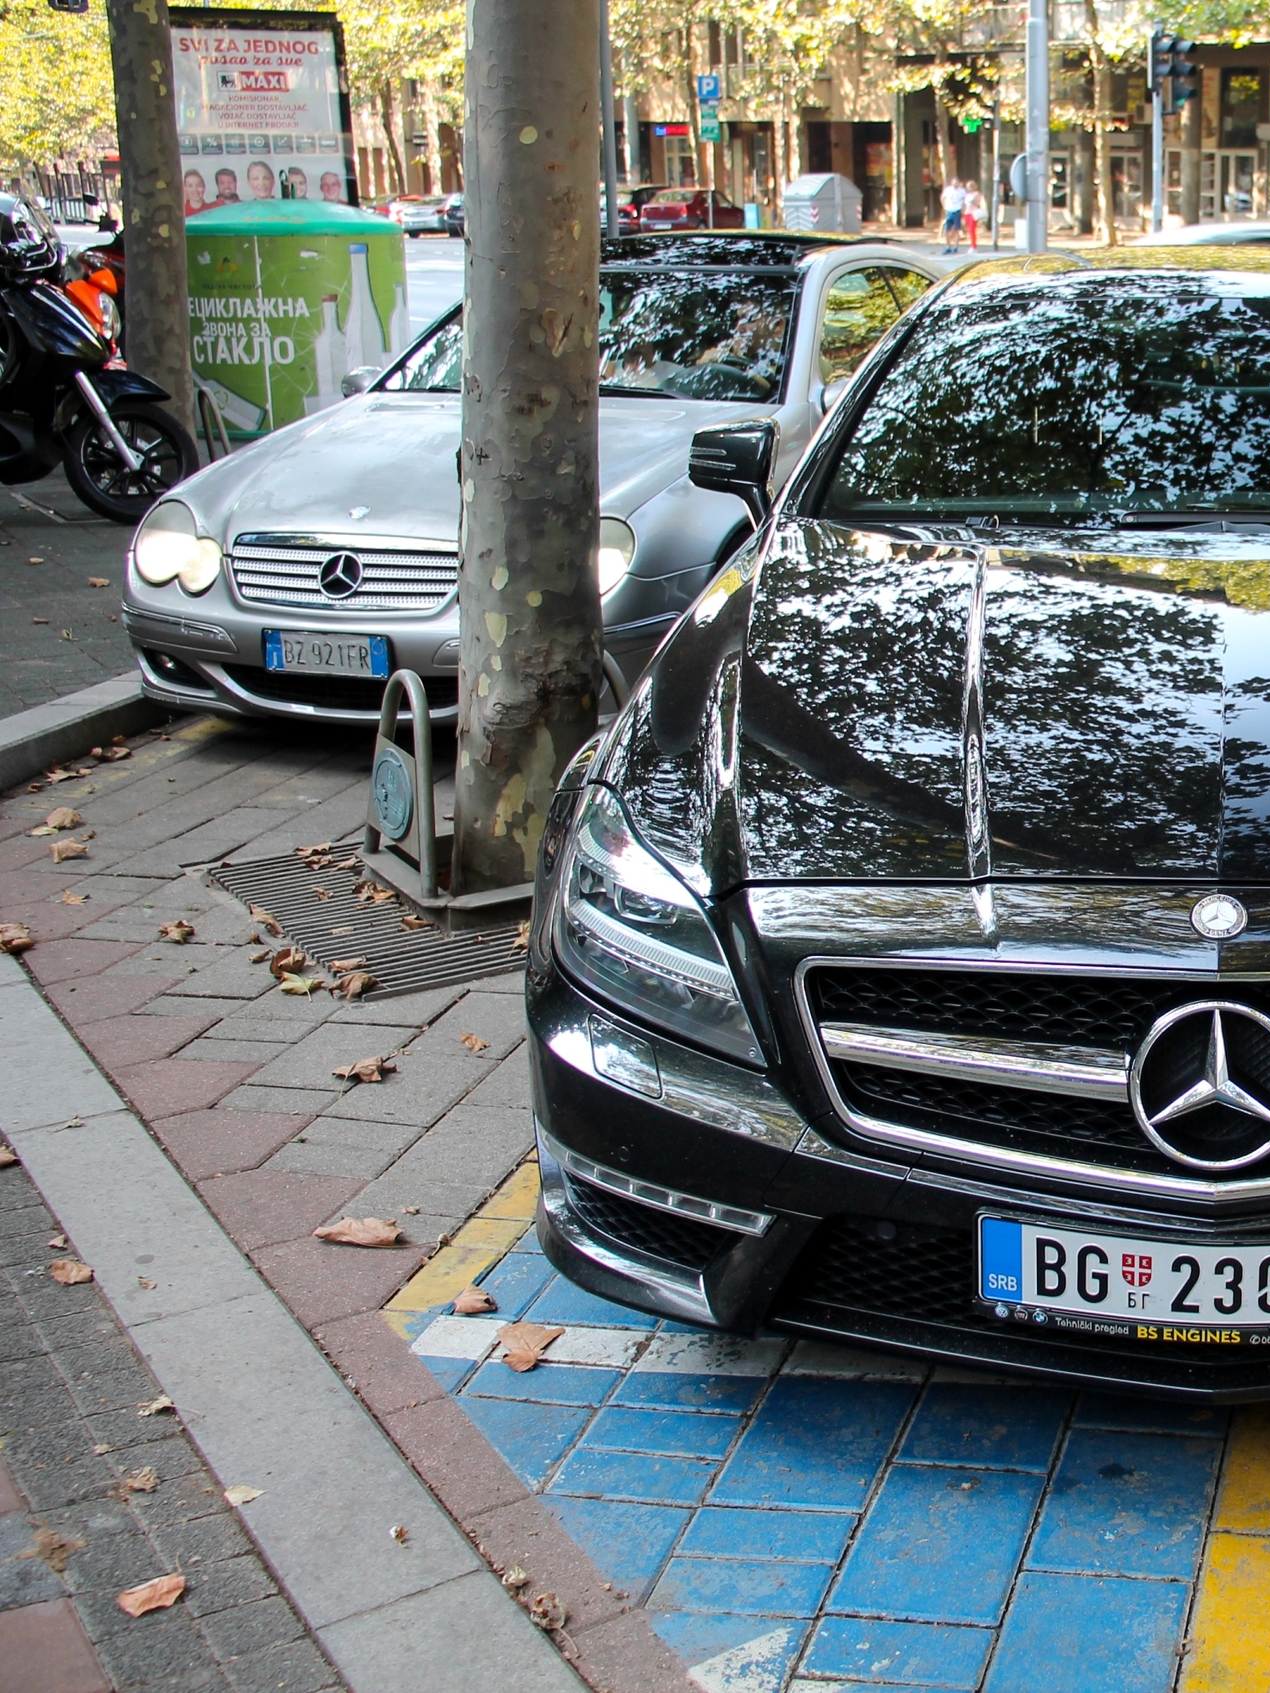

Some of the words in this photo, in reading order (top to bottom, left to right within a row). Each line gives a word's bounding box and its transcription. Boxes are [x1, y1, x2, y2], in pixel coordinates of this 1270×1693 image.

[179, 37, 208, 52] SVI
[214, 38, 240, 53] ZA
[243, 39, 319, 55] JEDNOG
[198, 55, 250, 69] posao
[252, 55, 273, 66] za
[277, 56, 303, 67] sve
[242, 74, 286, 89] MAXI
[702, 78, 715, 95] P
[201, 104, 255, 112] MAGACIONER
[219, 112, 245, 120] VOZAČ
[247, 112, 297, 120] DOSTAVLJAČ
[225, 121, 263, 129] INTERNET
[265, 121, 299, 129] PRODAJI
[188, 297, 310, 321] ЕЦИКЛАЖНА
[202, 322, 247, 337] ЗВОНА
[251, 322, 272, 337] ЗА
[193, 335, 296, 365] СТАКЛО
[283, 640, 306, 665] BZ
[312, 641, 370, 669] 921FR
[1036, 1236, 1110, 1303] BG
[988, 1273, 1018, 1292] SRB
[1094, 1322, 1129, 1335] pregled
[1137, 1326, 1158, 1340] BS
[1163, 1329, 1241, 1343] ENGINES
